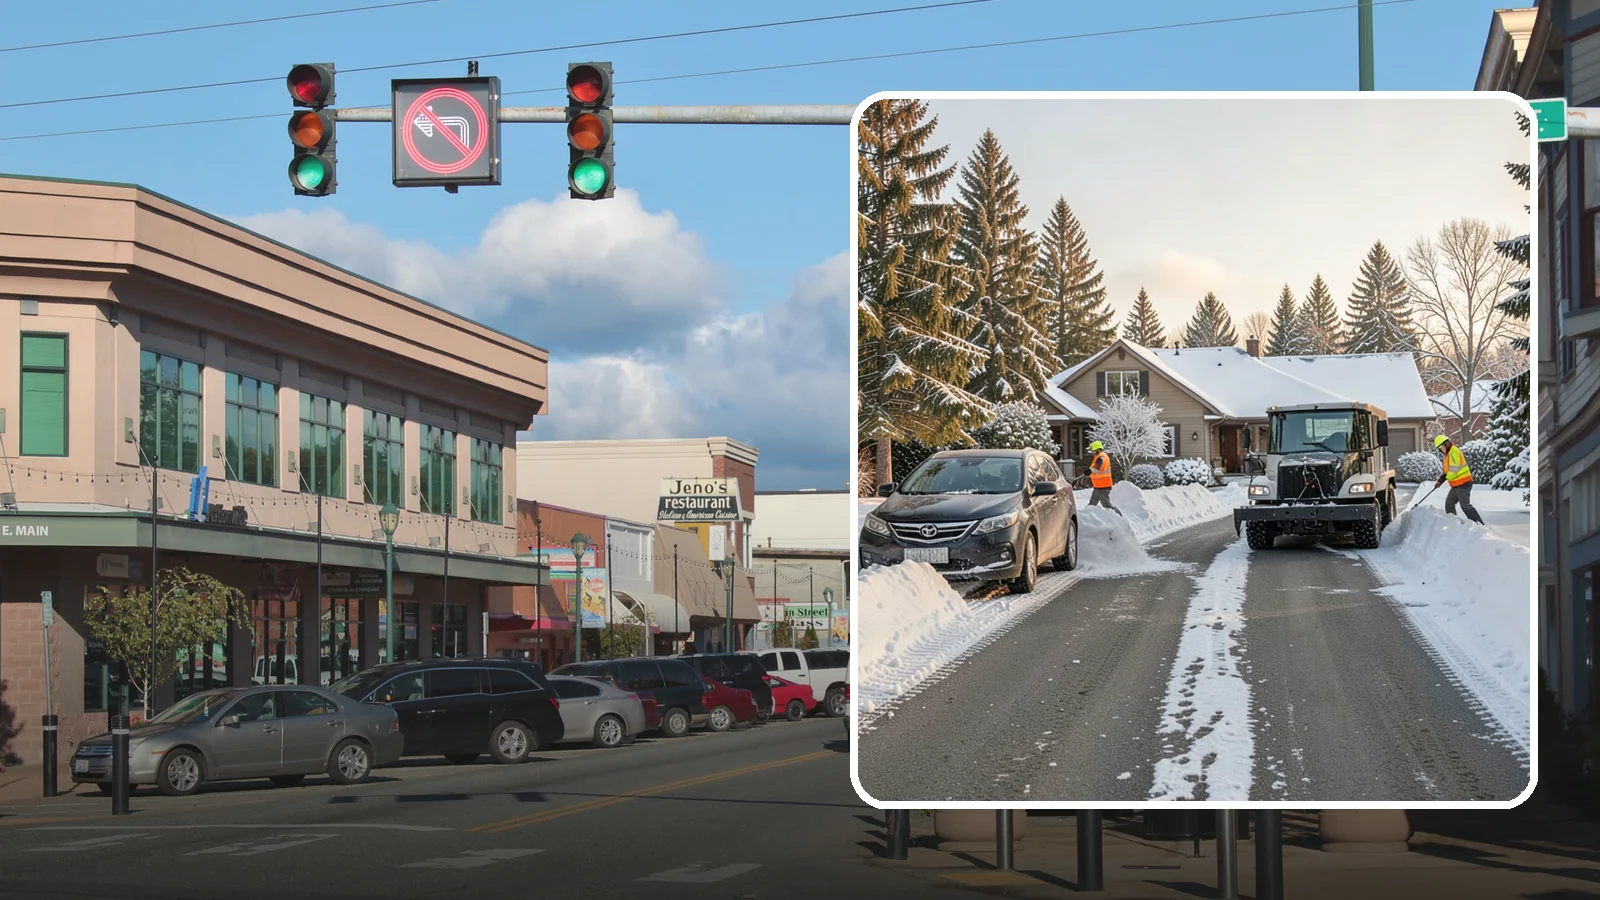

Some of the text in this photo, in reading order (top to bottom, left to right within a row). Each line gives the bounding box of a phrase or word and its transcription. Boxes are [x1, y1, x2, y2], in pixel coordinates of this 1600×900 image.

[669, 480, 728, 495] Jeno's
[665, 496, 731, 509] restaurant
[658, 509, 681, 520] Italian
[686, 509, 714, 520] American
[714, 509, 739, 520] Cuisine
[2, 525, 49, 536] E. MAIN
[797, 607, 828, 617] Street
